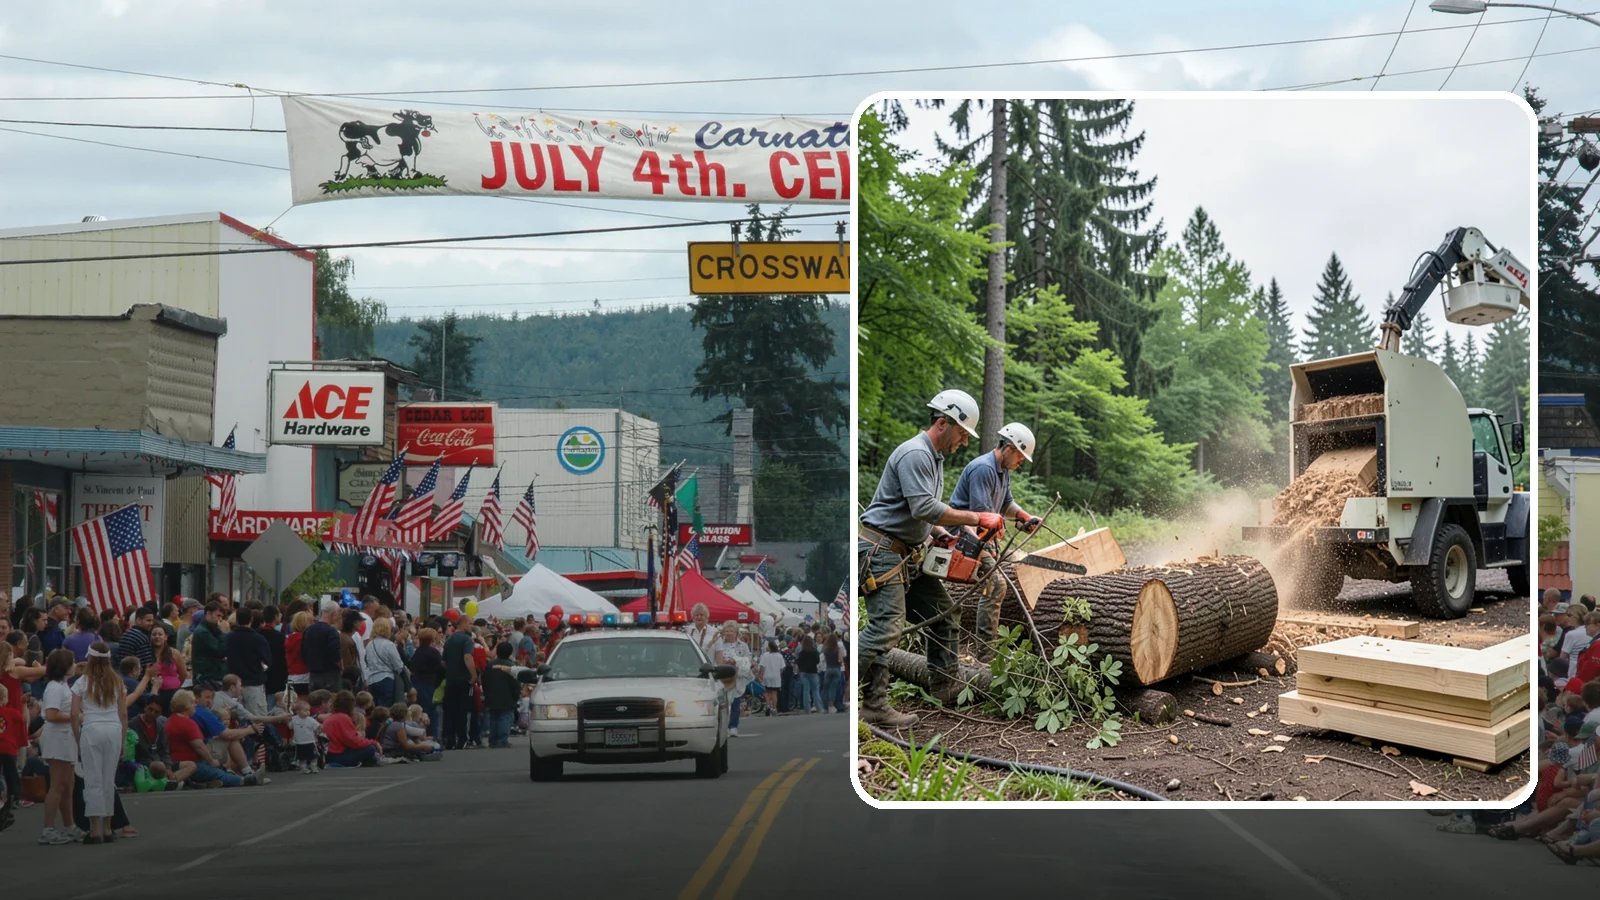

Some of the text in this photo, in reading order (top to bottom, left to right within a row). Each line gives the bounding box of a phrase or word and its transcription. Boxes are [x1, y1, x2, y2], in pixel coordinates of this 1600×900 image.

[481, 140, 605, 192] JULY
[632, 150, 746, 198] 4th.
[697, 253, 850, 281] CROSSWA
[282, 380, 373, 420] ACE
[406, 409, 452, 422] CEDAR
[283, 420, 371, 437] Hardware
[353, 467, 387, 478] Simpl
[96, 486, 124, 495] Vincent
[126, 486, 136, 495] de
[137, 486, 155, 496] Paul
[688, 527, 741, 535] CRNATION
